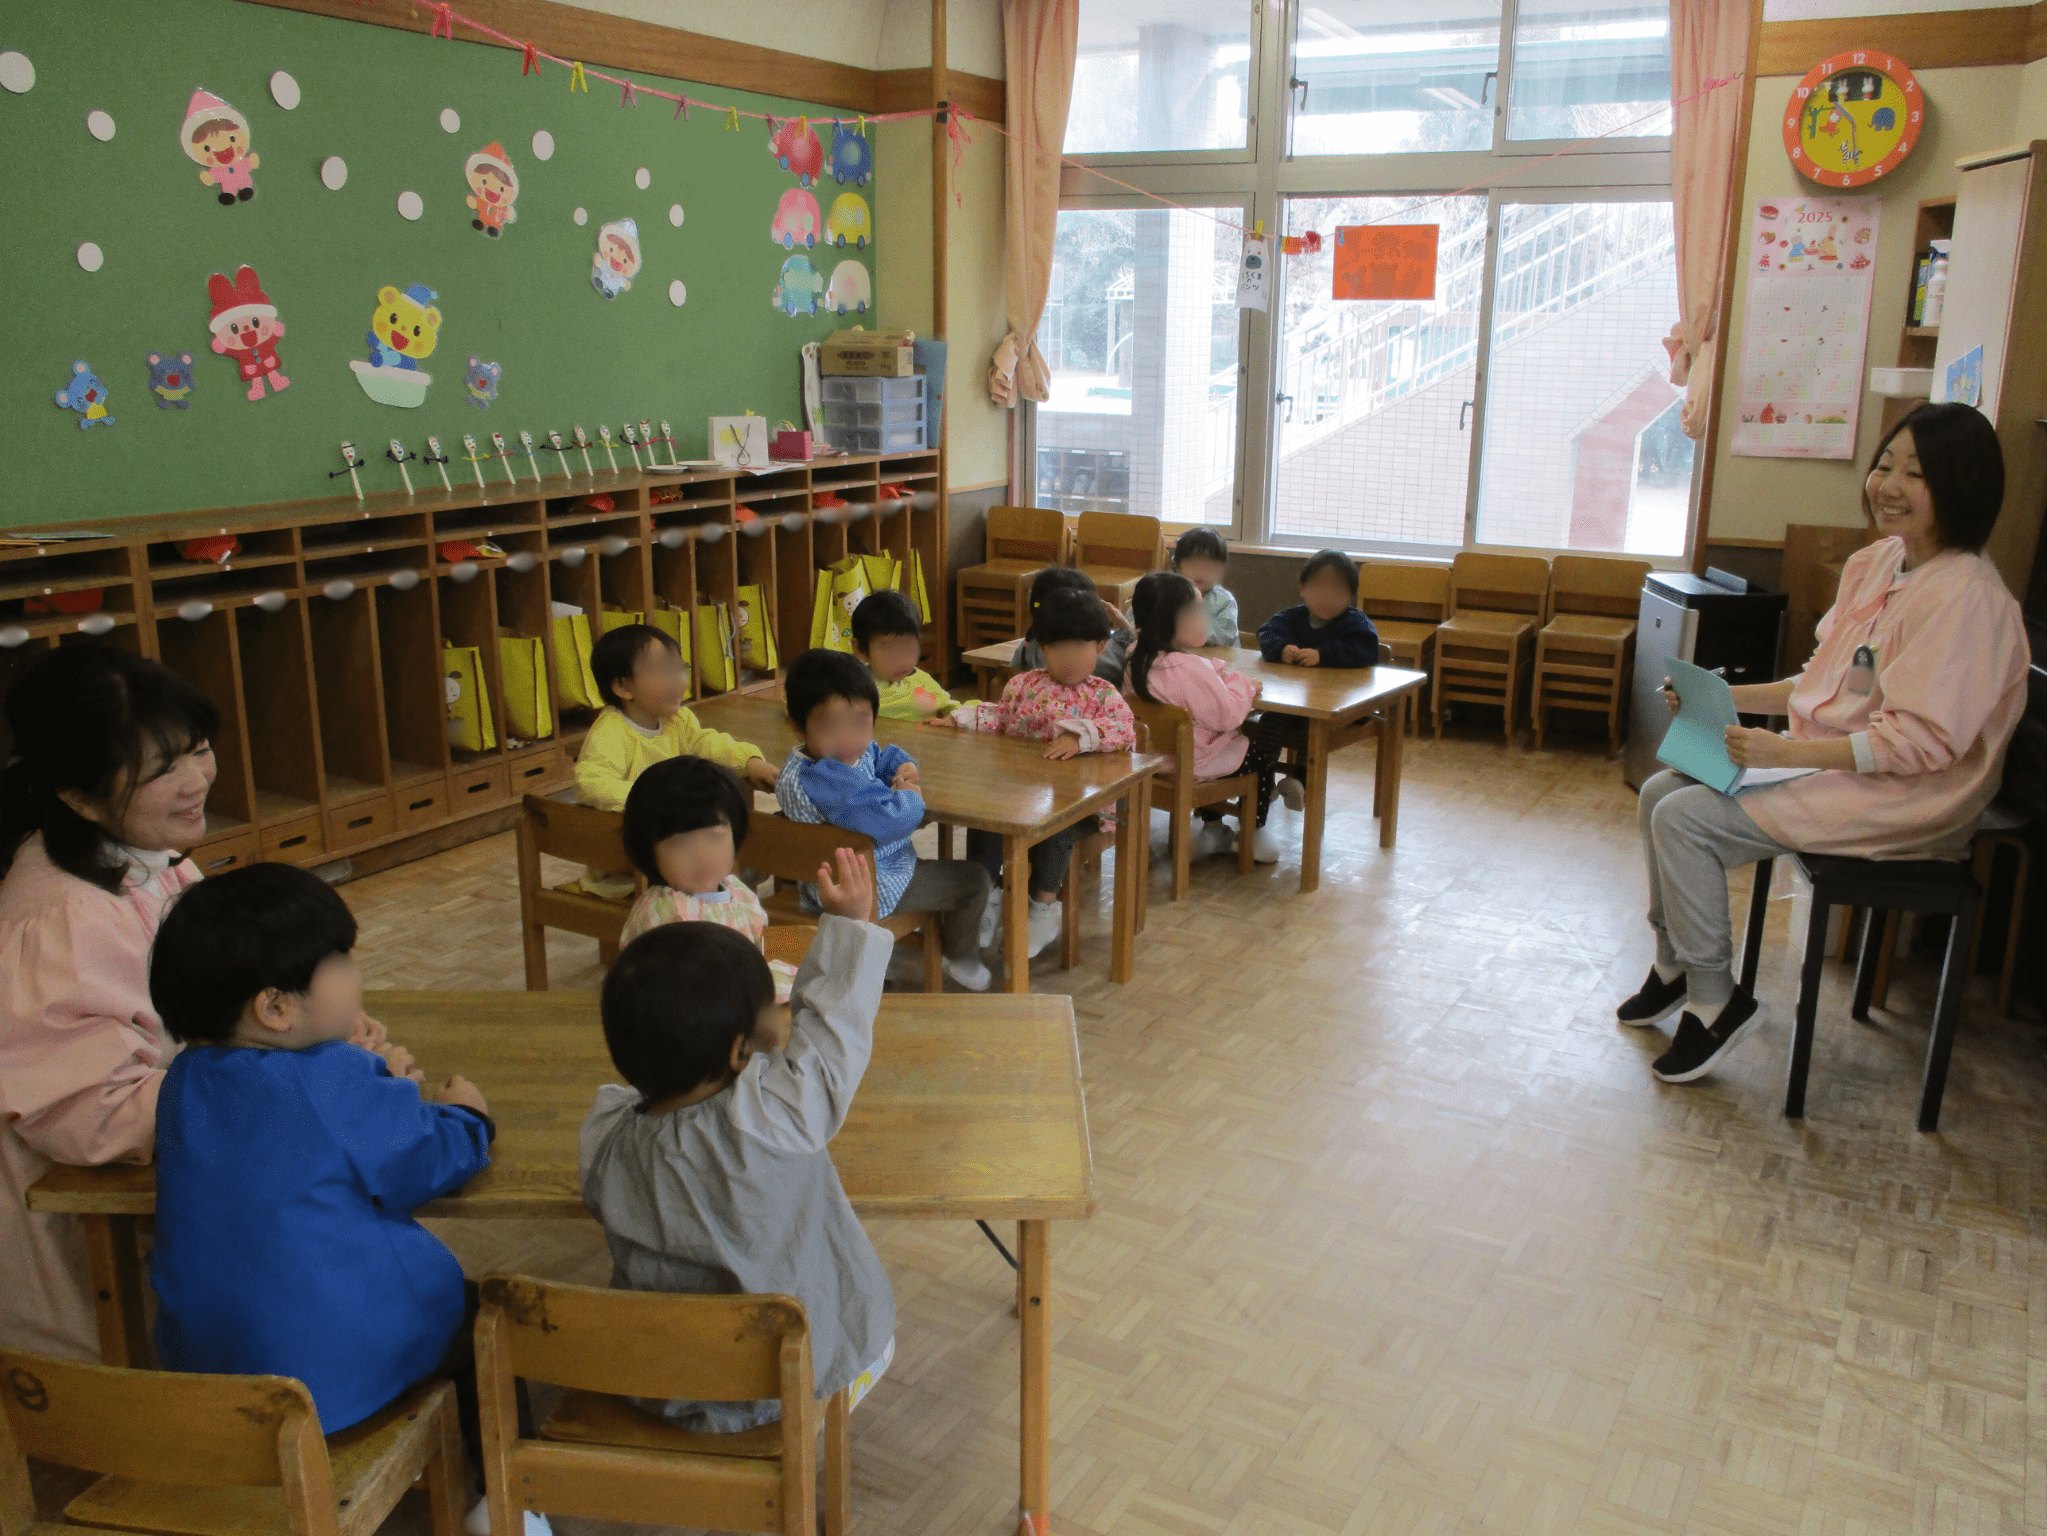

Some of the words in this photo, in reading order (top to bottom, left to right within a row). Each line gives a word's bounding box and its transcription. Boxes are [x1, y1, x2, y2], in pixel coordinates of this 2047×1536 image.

[1852, 53, 1866, 64] 12
[1821, 63, 1833, 74] 11
[1886, 59, 1892, 70] 1
[1906, 80, 1915, 92] 2
[1797, 87, 1809, 98] 10
[1911, 111, 1920, 122] 3
[1787, 117, 1796, 129] 9
[1792, 147, 1801, 158] 8
[1898, 142, 1907, 153] 4
[1813, 168, 1822, 178] 7
[1874, 165, 1883, 177] 5
[1842, 175, 1851, 186] 6
[1797, 212, 1833, 223] 2025
[1242, 271, 1262, 281] しろくま
[1240, 283, 1259, 291] パンツ
